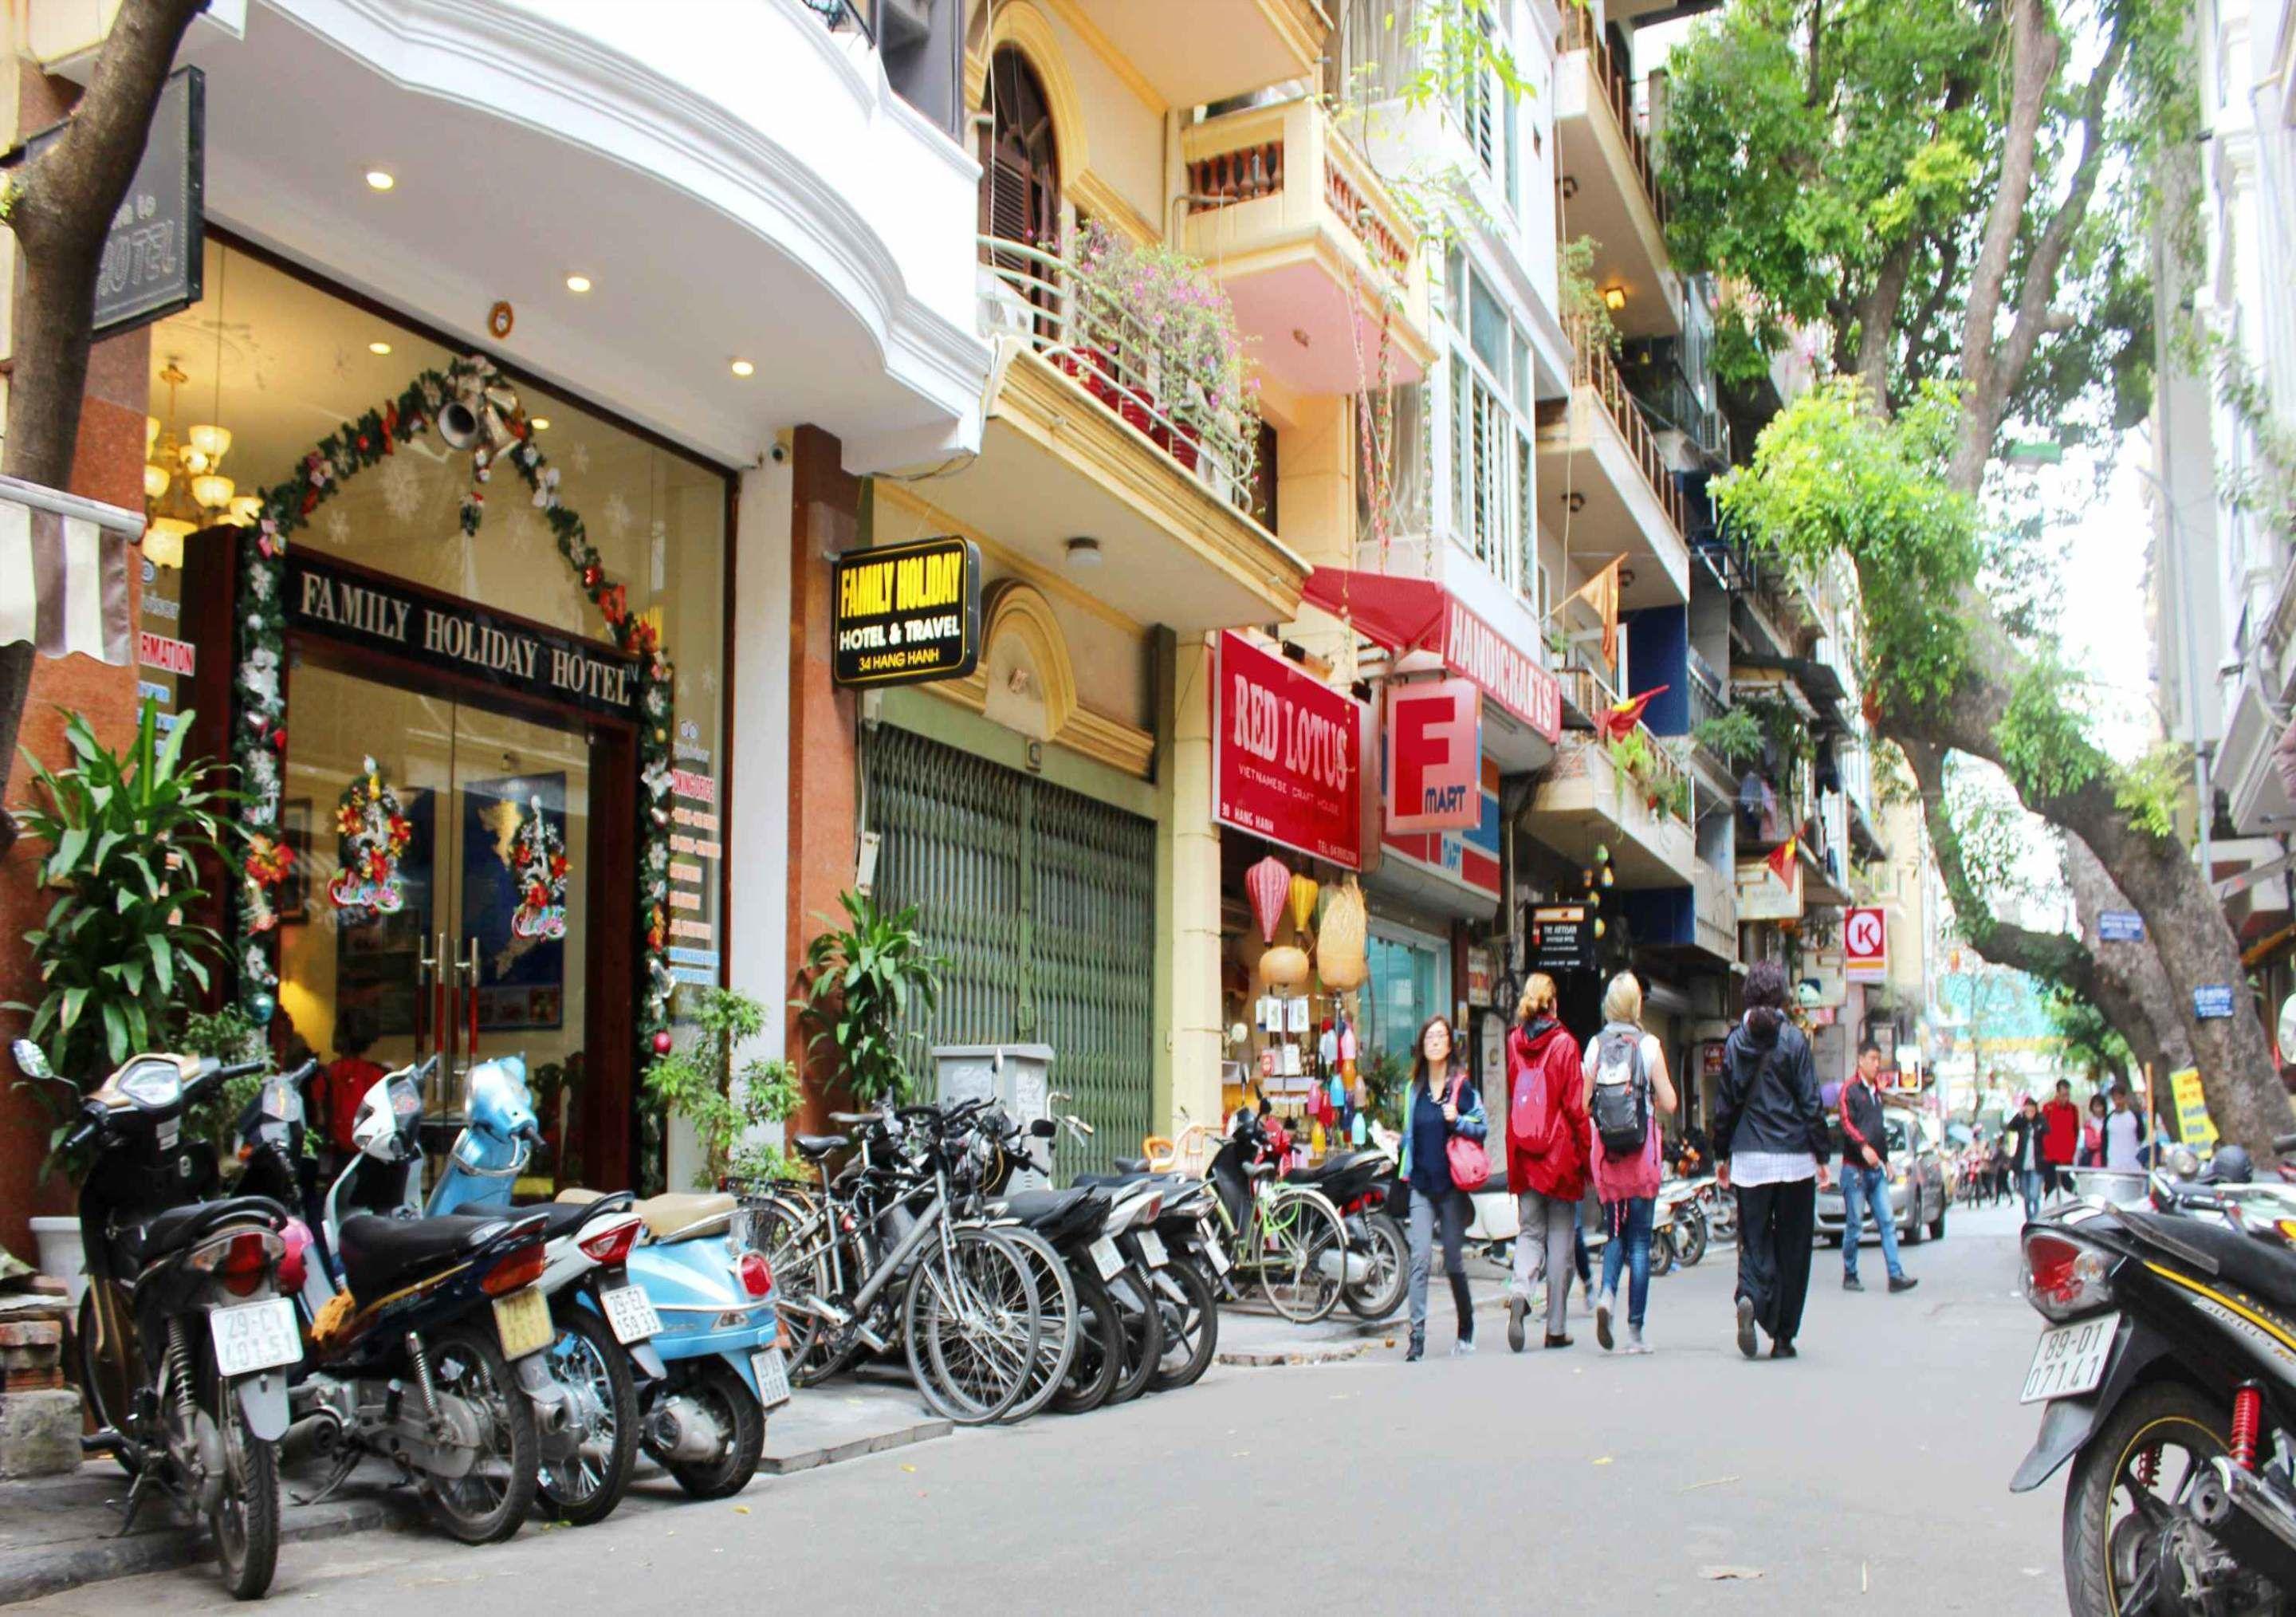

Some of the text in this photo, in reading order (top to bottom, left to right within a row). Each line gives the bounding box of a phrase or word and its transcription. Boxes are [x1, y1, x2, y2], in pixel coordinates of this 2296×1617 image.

[840, 551, 961, 618] FAMILY HOLIDAY
[300, 571, 631, 707] FAMILY HOLIDAY HOTEL
[839, 615, 961, 651] HOTEL & TRAVEL
[859, 647, 940, 672] 34 HANG HANH
[1447, 600, 1554, 732] HANDICRAFTS
[1234, 673, 1347, 792] RED LOTUS
[1395, 697, 1455, 817] F
[1238, 763, 1288, 793] VIETNAMESE
[1425, 785, 1466, 815] MART
[1235, 807, 1253, 827] HANG
[1256, 813, 1274, 833] HANH
